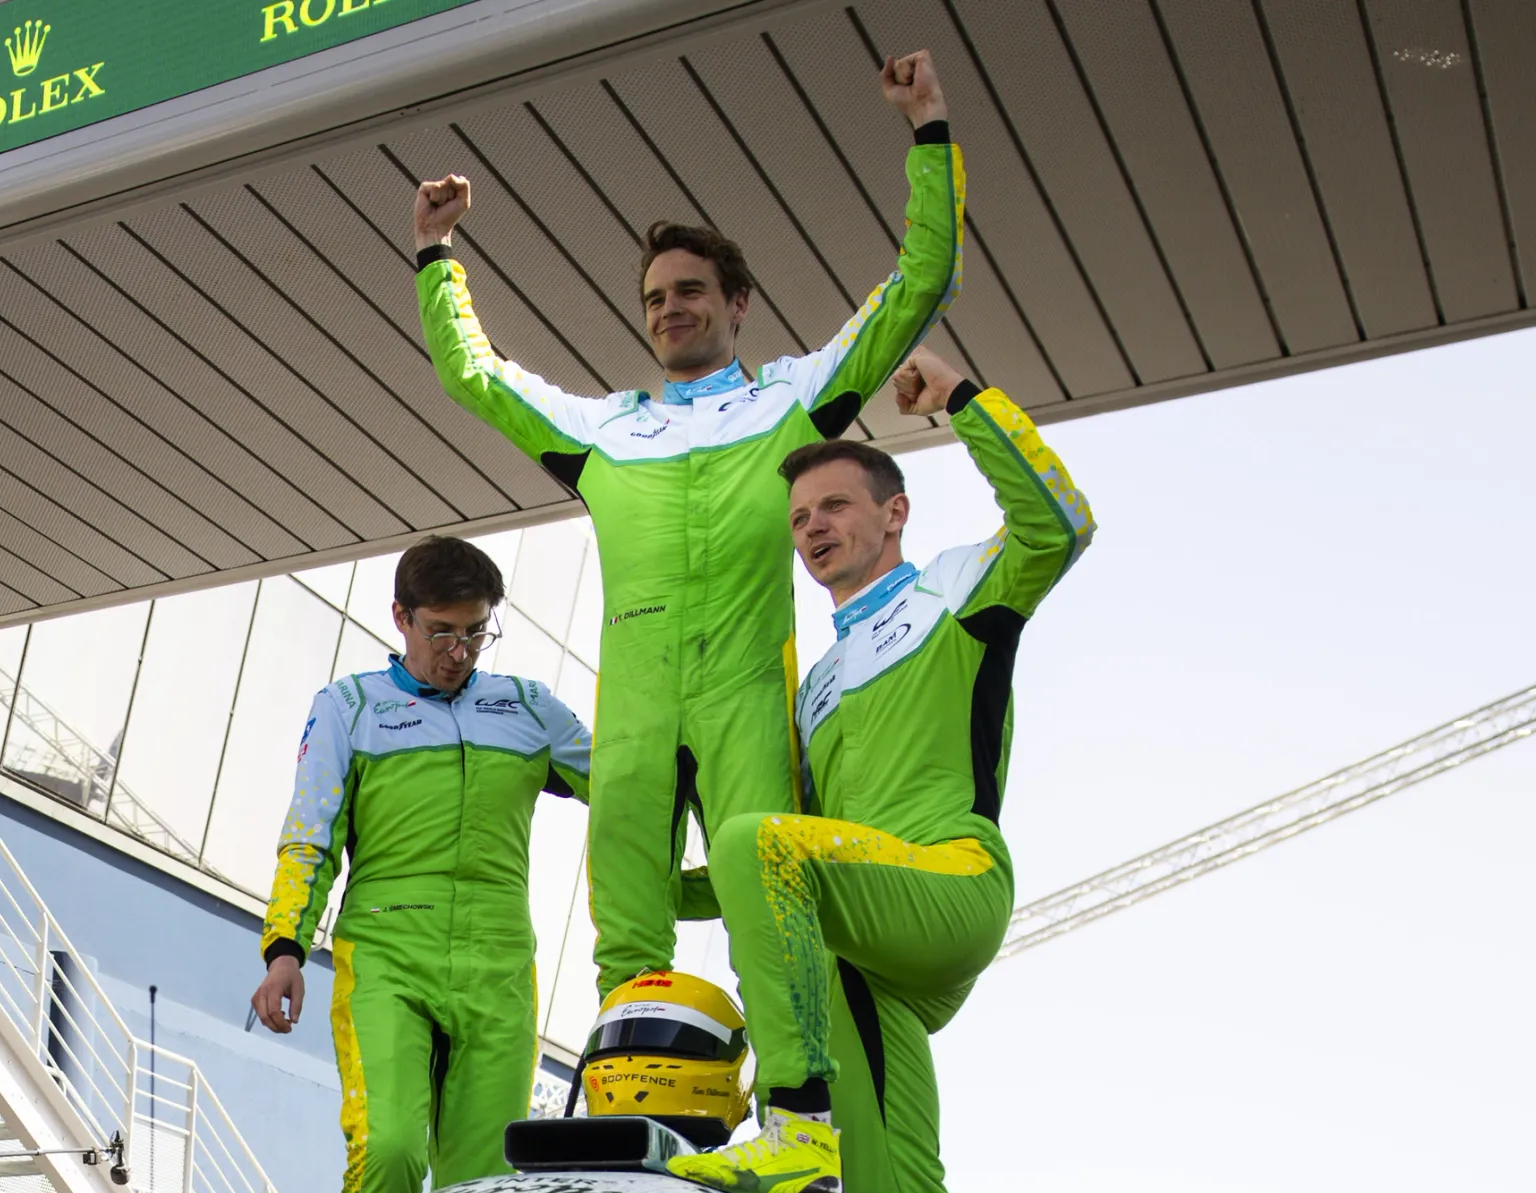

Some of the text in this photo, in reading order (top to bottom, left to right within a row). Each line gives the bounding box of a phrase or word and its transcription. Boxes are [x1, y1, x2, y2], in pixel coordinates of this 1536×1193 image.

[624, 605, 667, 619] DILLMANN
[379, 719, 422, 731] GOODYEAR
[602, 1073, 677, 1088] BODYFENCE
